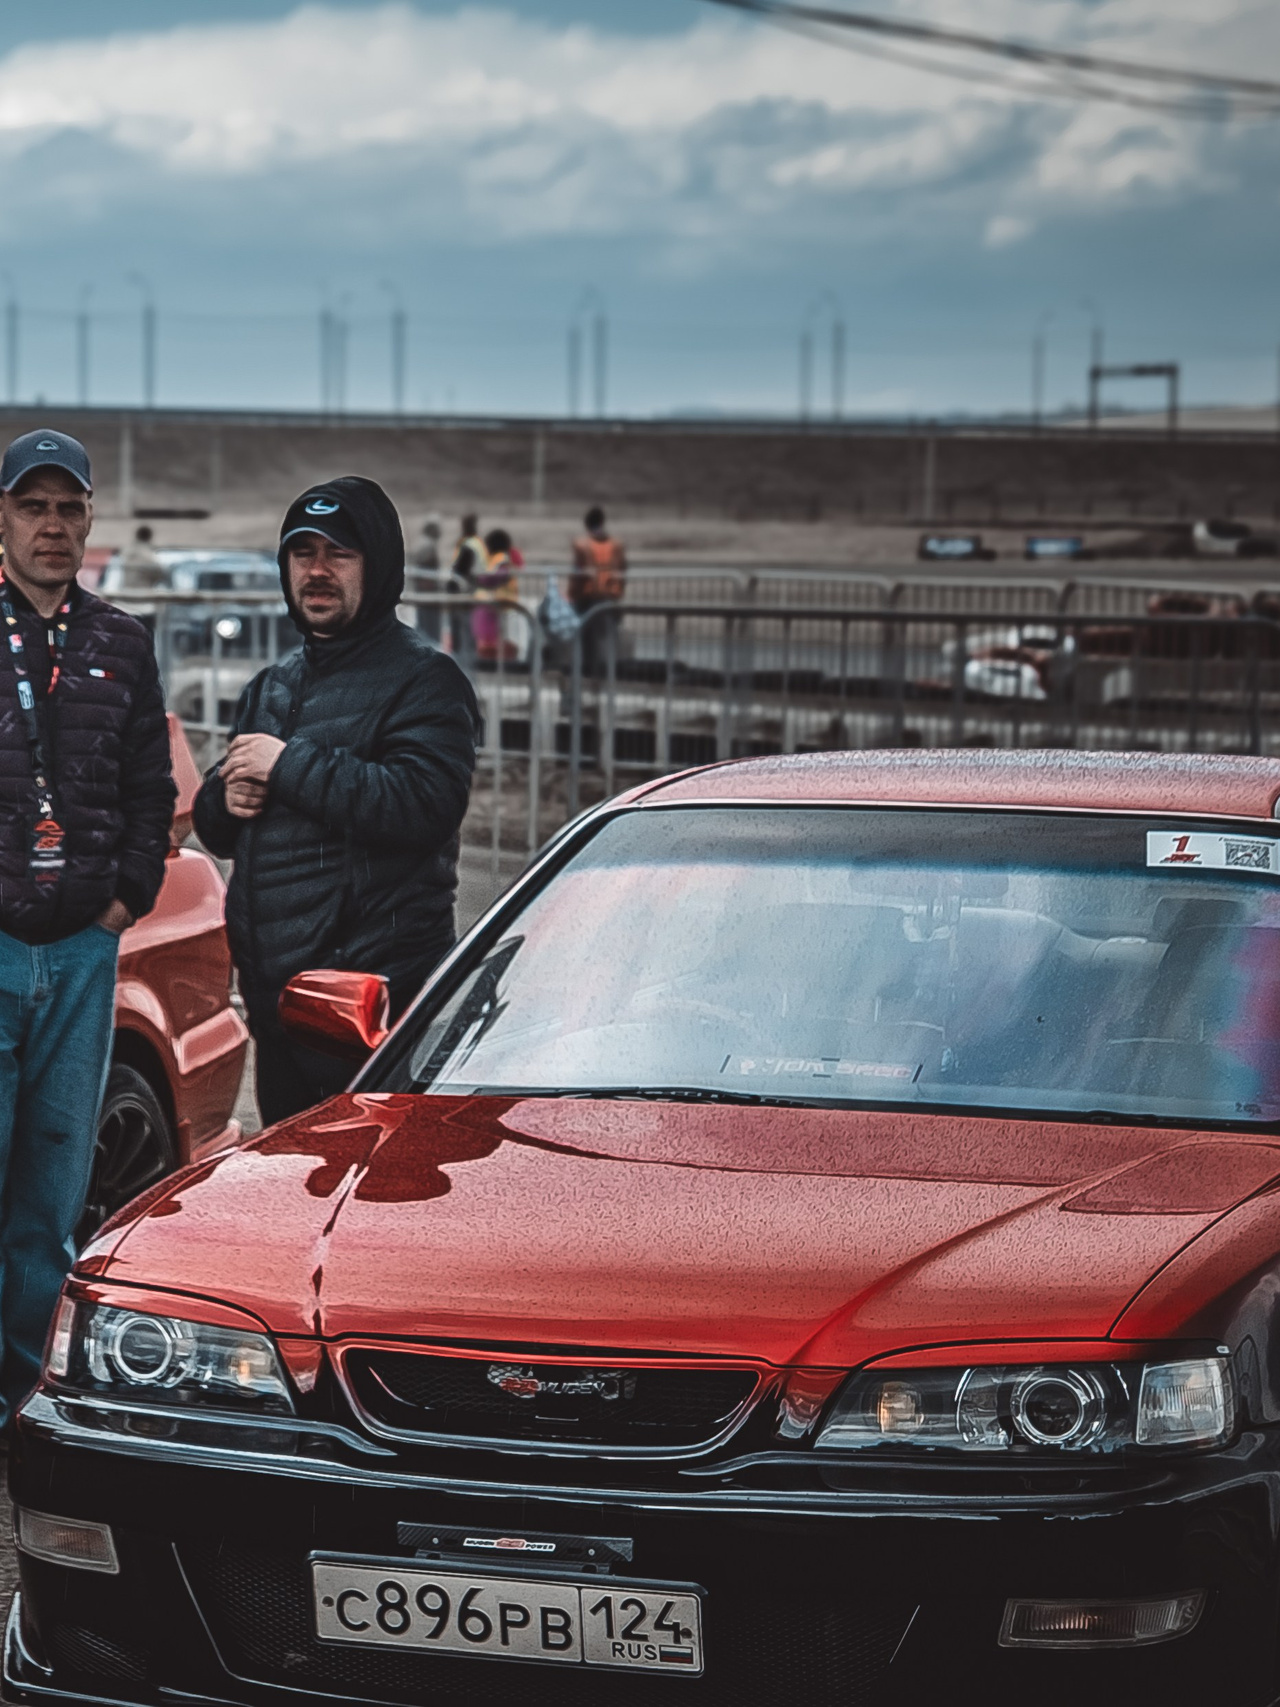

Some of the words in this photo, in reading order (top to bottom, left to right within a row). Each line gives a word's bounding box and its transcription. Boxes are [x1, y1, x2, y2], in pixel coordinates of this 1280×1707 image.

[1172, 835, 1191, 853] 1
[589, 1595, 682, 1645] 124
[612, 1643, 657, 1662] RUS
